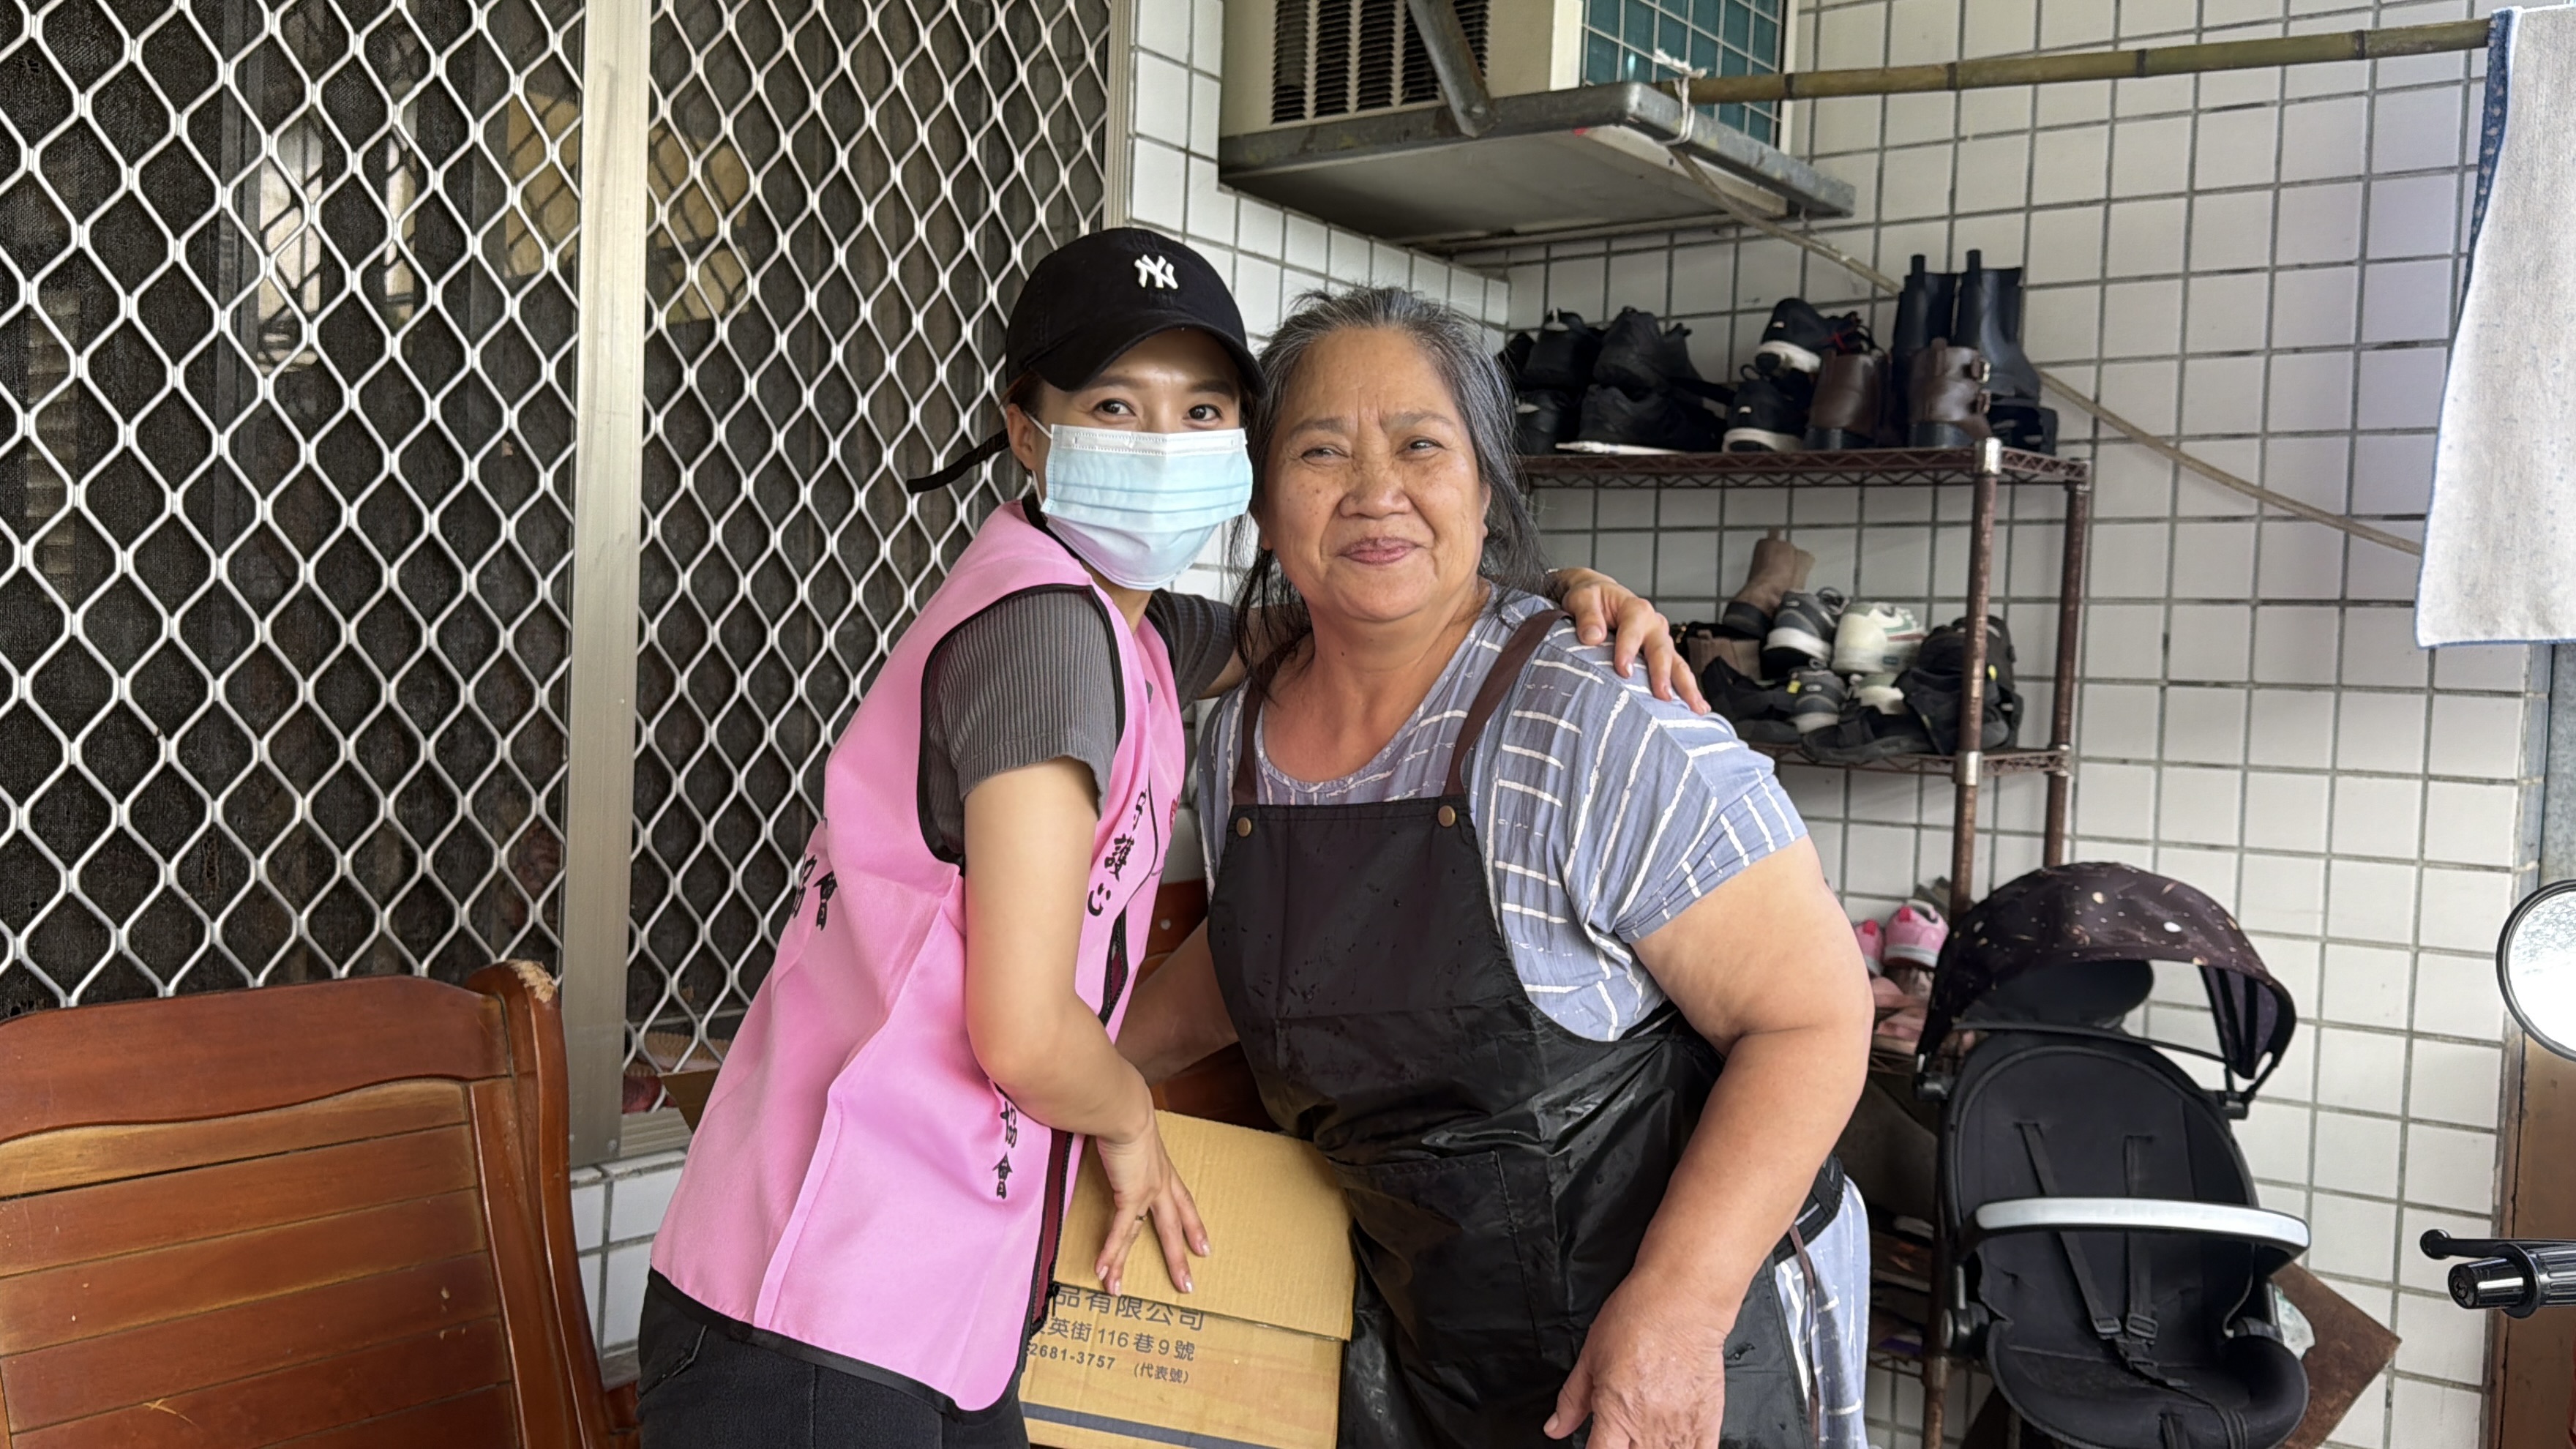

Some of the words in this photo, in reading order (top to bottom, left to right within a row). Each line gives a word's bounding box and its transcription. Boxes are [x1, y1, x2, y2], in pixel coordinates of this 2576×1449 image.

[1134, 254, 1179, 289] NY
[1038, 1316, 1195, 1362] 英街116巷9號
